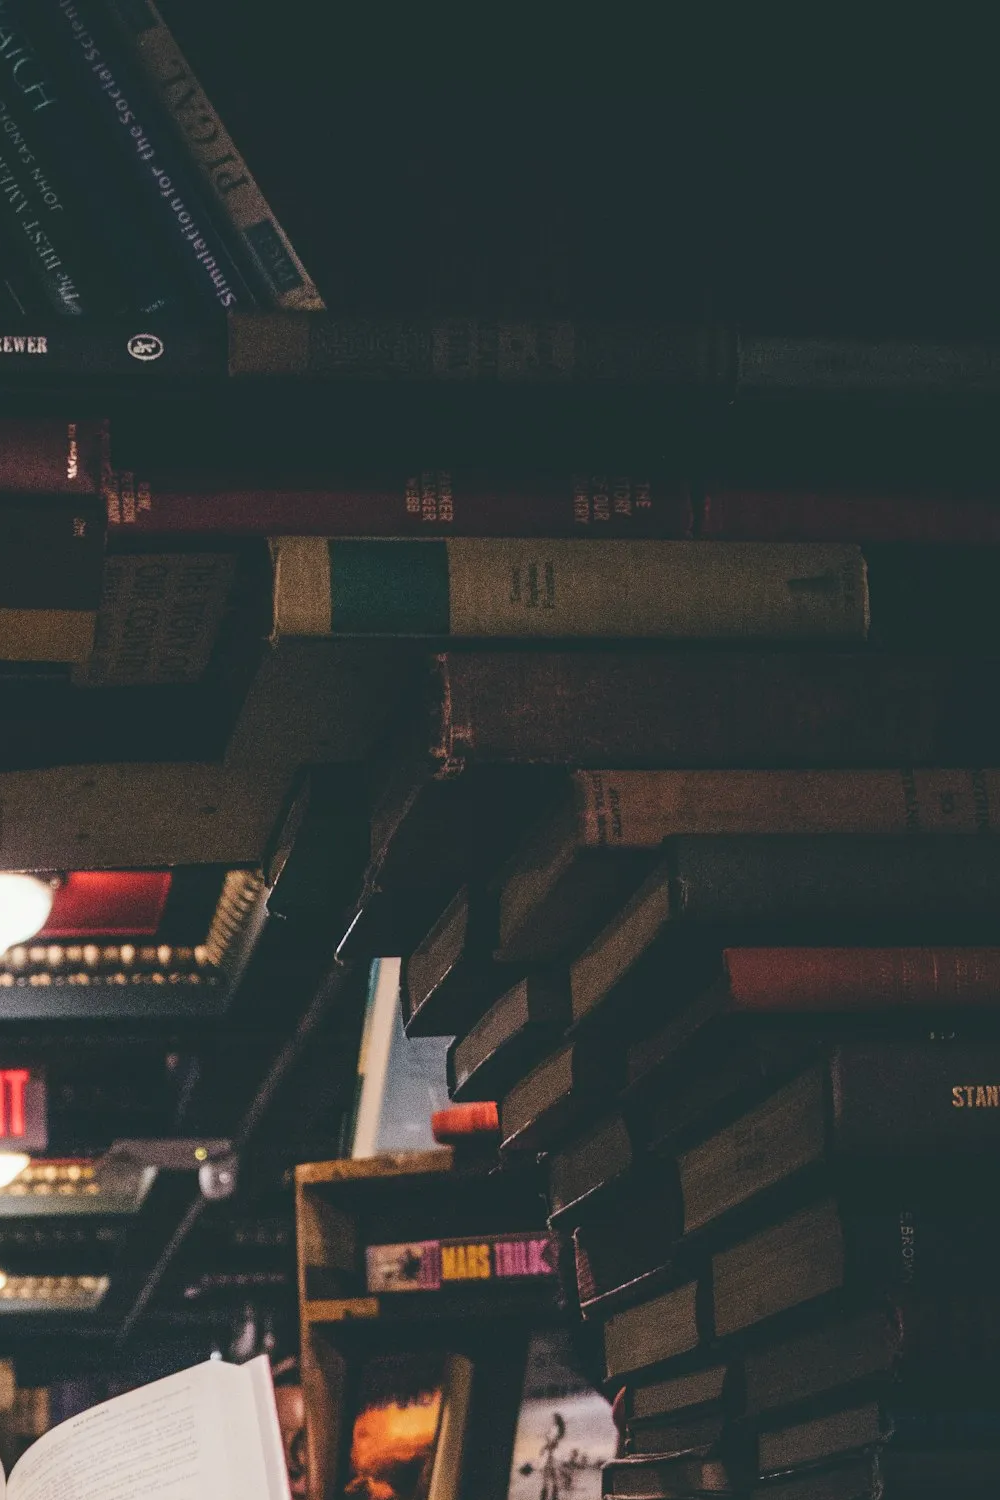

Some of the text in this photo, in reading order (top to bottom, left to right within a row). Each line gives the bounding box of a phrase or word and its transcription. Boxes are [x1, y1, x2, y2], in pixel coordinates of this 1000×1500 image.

[91, 62, 138, 127] Social
[32, 169, 64, 213] JOHN
[20, 221, 64, 275] BEST
[168, 192, 239, 307] Simulation
